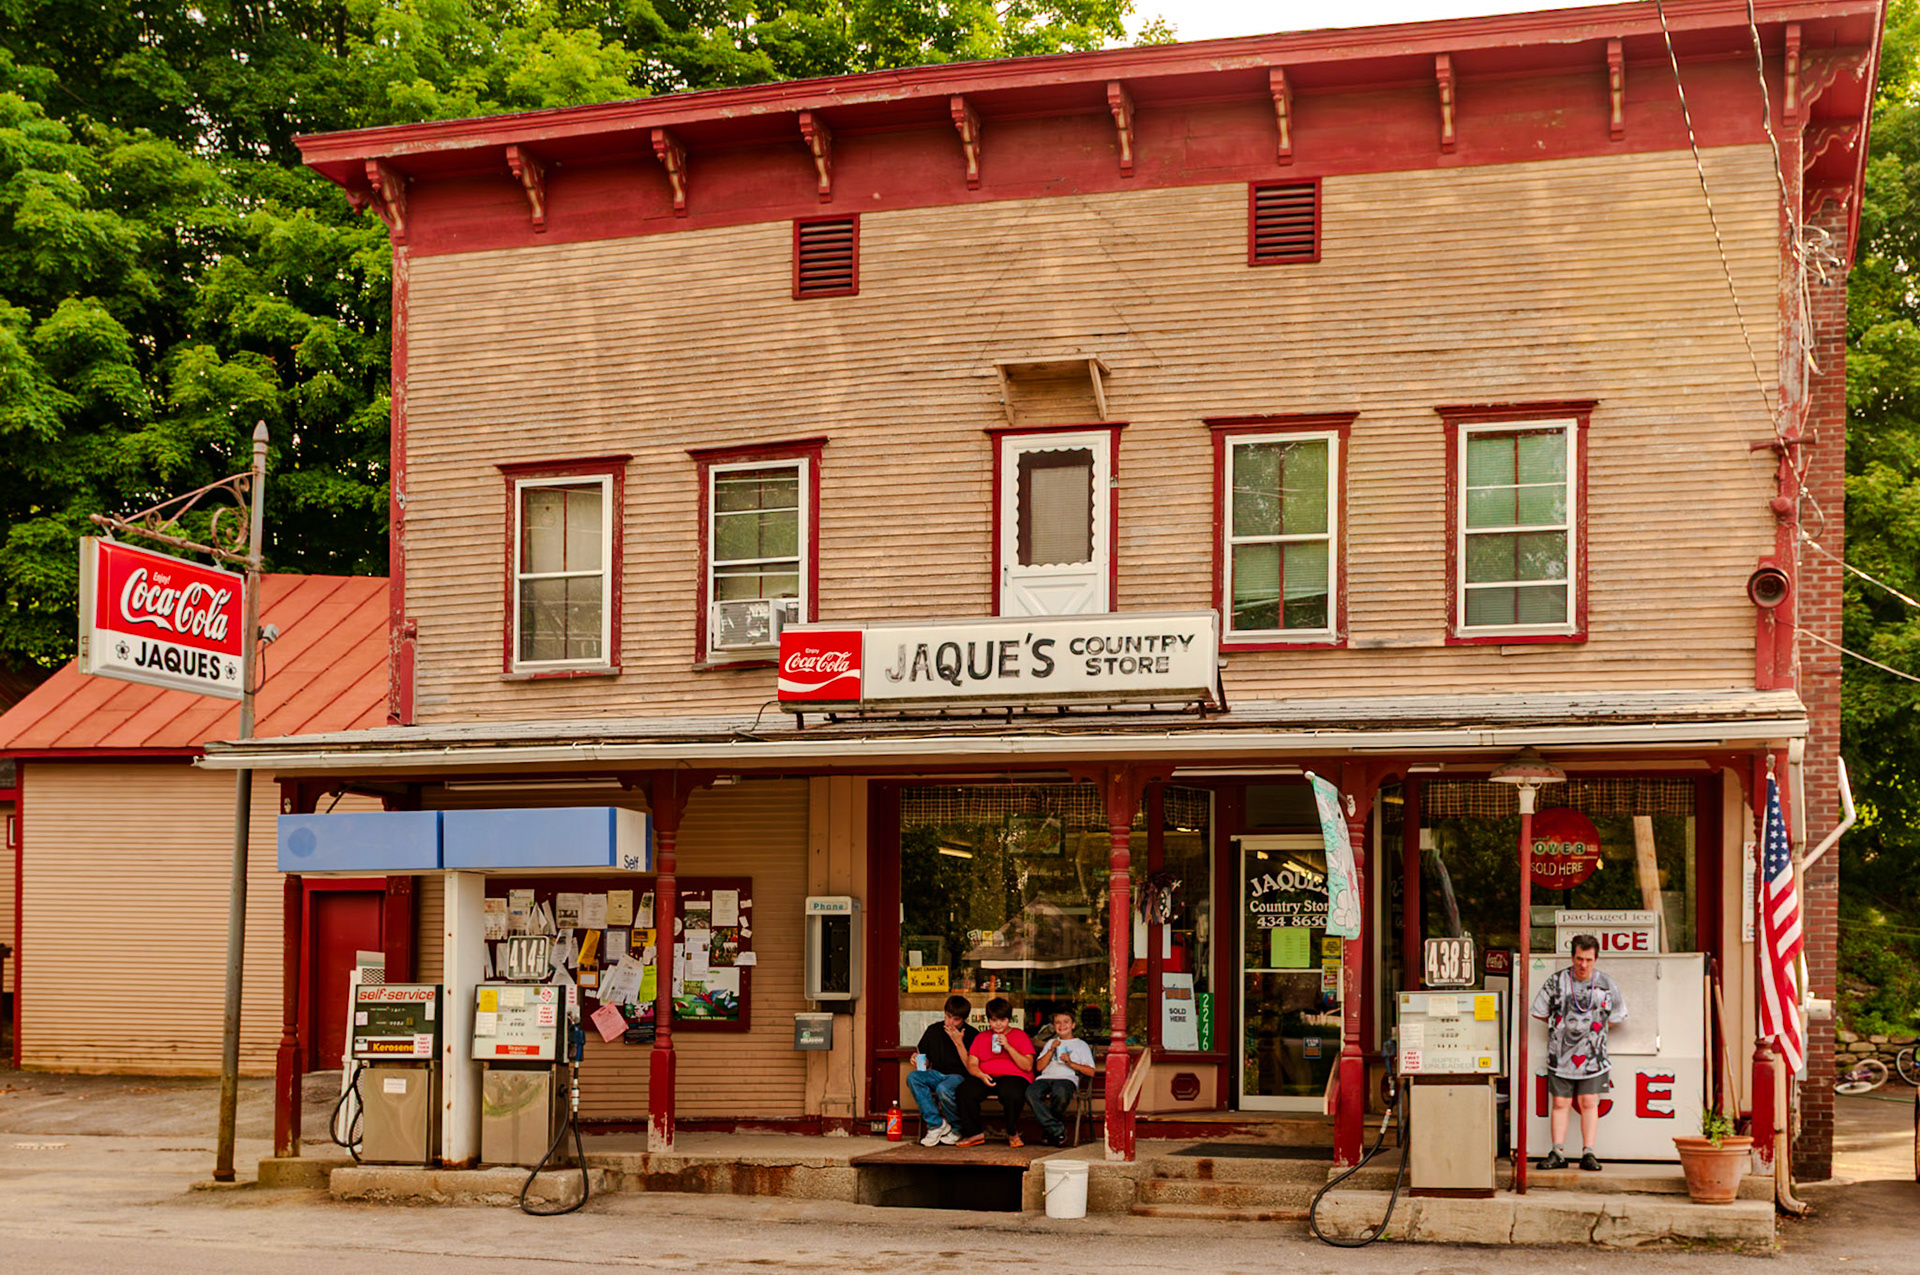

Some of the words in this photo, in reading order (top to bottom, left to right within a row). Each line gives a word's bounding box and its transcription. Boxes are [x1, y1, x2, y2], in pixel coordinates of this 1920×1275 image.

[120, 567, 232, 641] Coca-Cola
[135, 641, 221, 680] JAQUES
[784, 651, 853, 674] Coca-Cola
[885, 632, 1056, 687] JAQUE'S
[1069, 633, 1196, 656] COUNTRY
[1085, 656, 1169, 676] STORE
[1530, 841, 1585, 855] OWER
[624, 854, 639, 870] Self
[1558, 861, 1584, 876] HERE
[813, 902, 844, 910] Phone
[1249, 900, 1301, 915] Country
[1303, 899, 1329, 912] Stor
[1257, 917, 1286, 927] 434
[1291, 917, 1328, 927] 8650
[1562, 912, 1627, 922] packaged
[1632, 912, 1653, 921] ice
[1601, 931, 1648, 951] ICE
[358, 988, 435, 1000] self-service
[1535, 1066, 1675, 1118] IE
